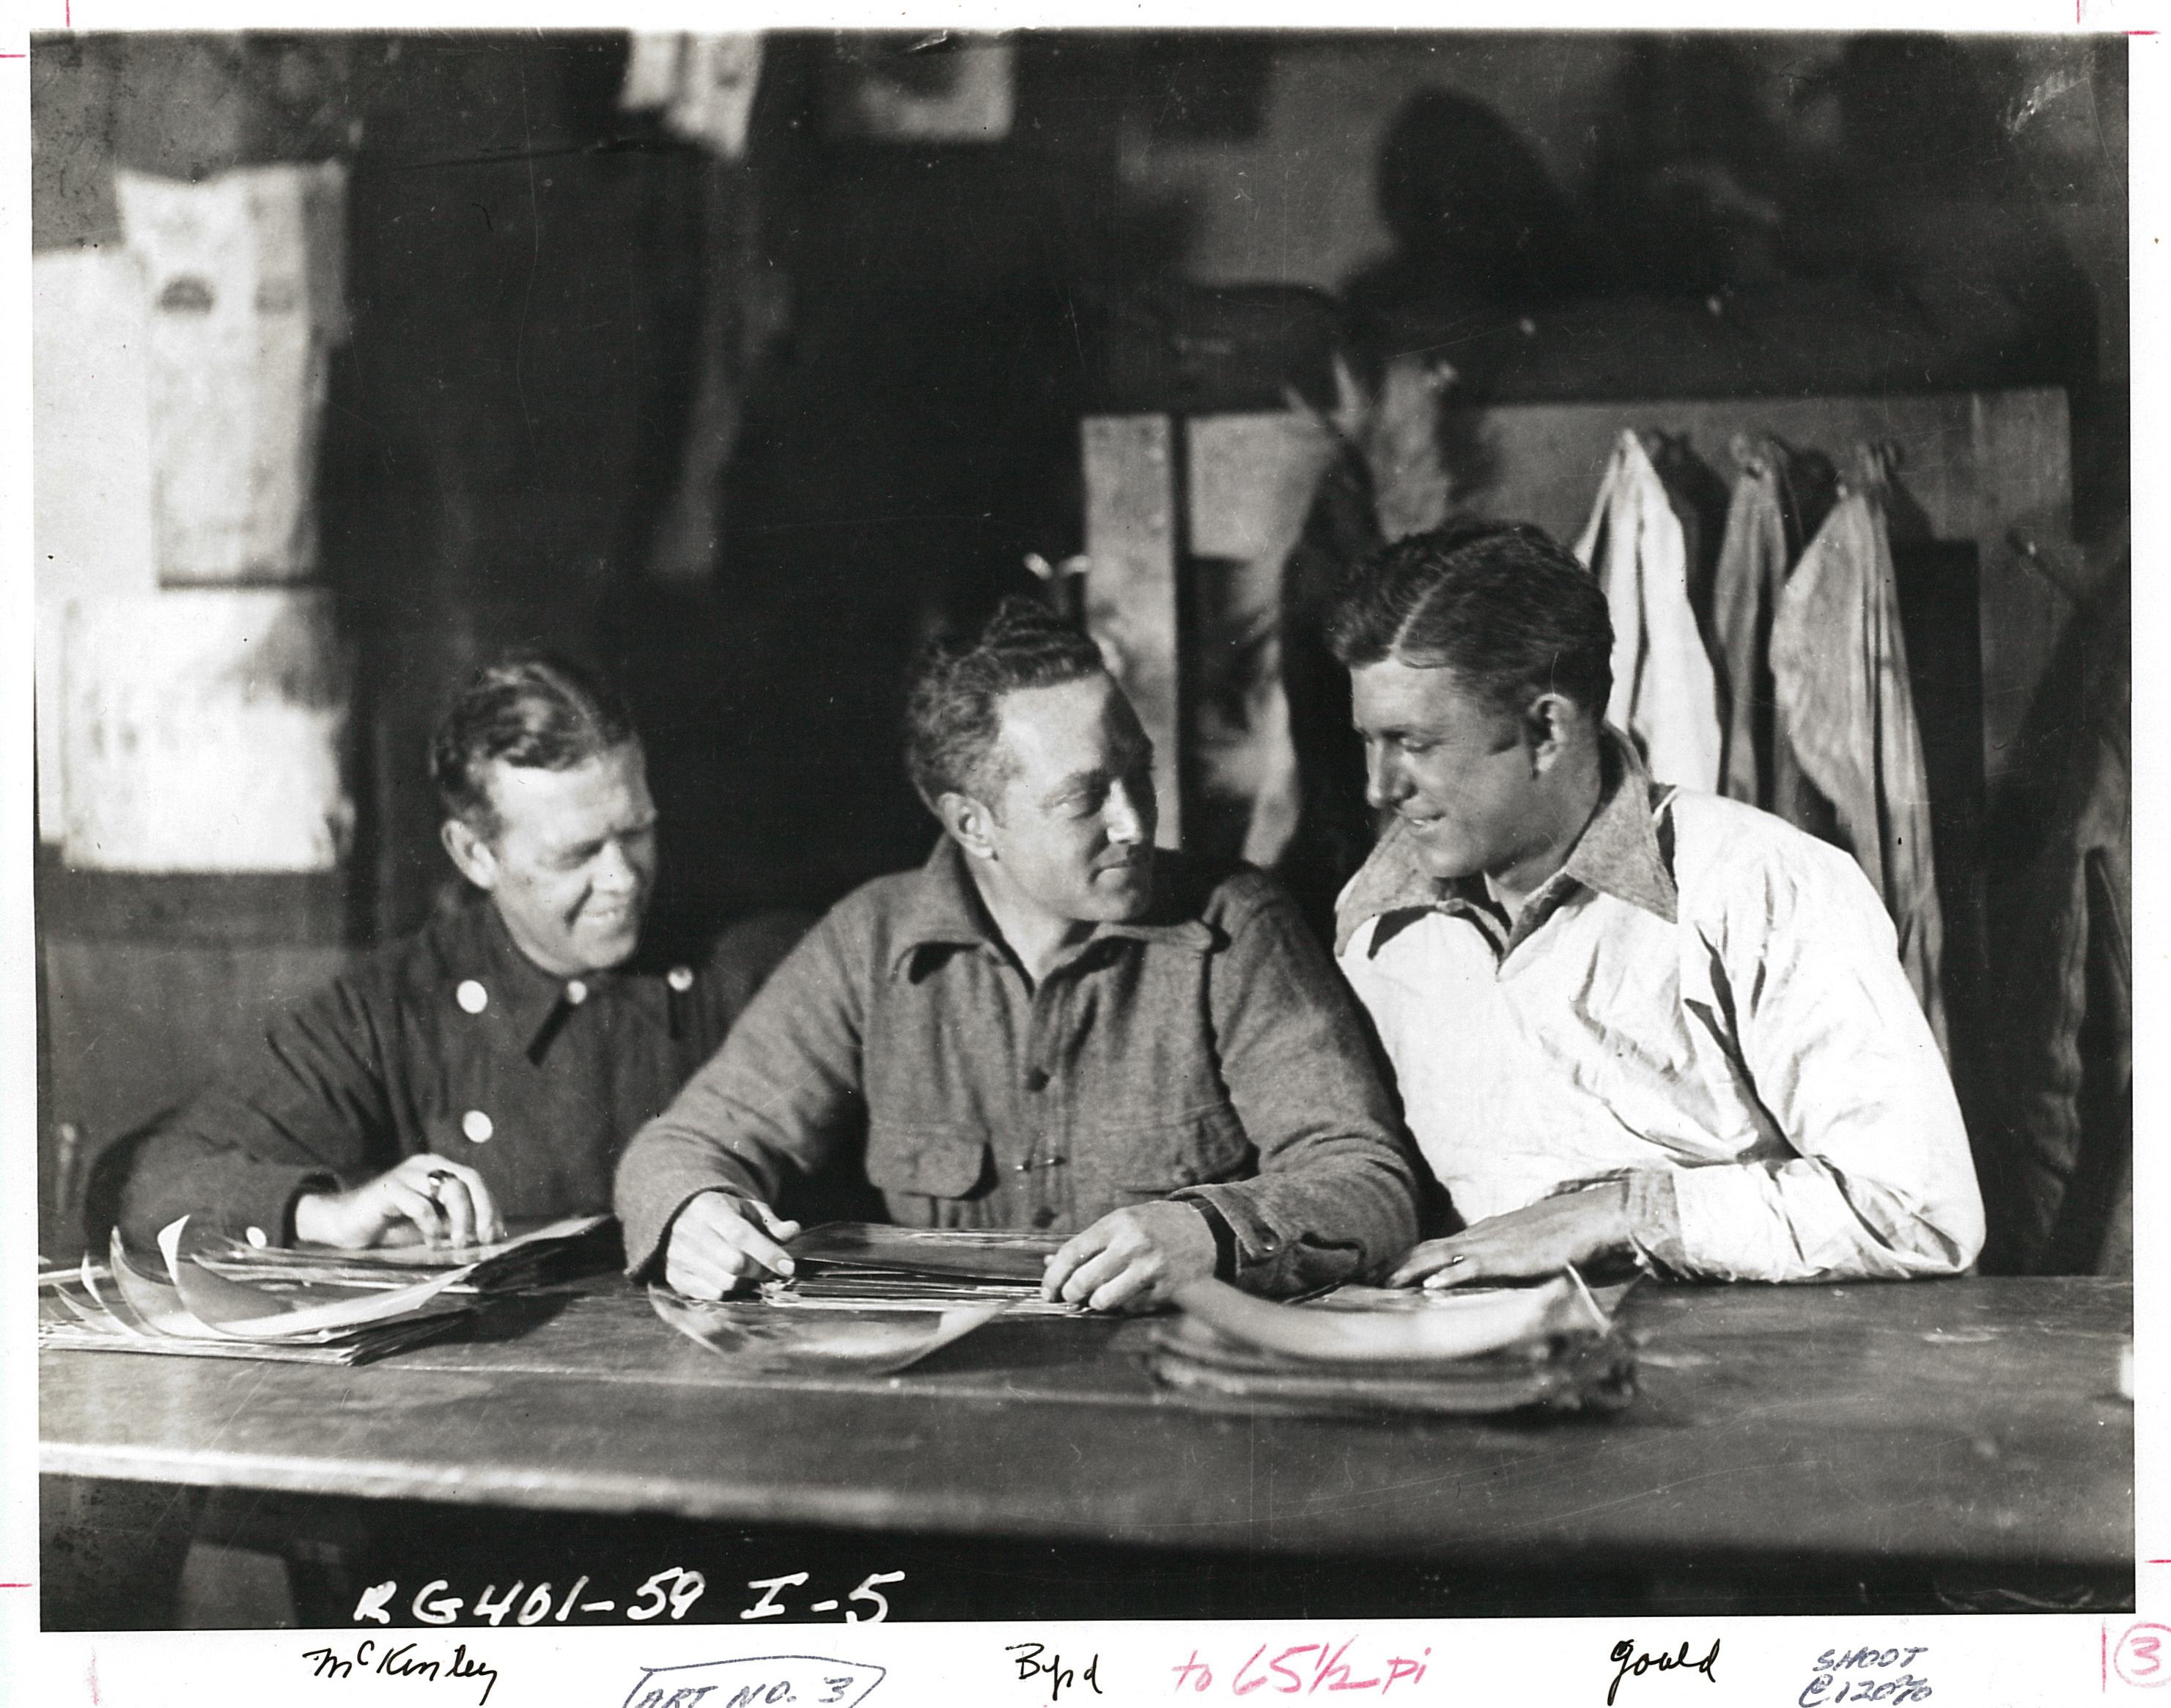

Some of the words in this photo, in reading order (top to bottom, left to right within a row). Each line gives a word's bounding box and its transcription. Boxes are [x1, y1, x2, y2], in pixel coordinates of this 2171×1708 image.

[1005, 1642, 1103, 1701] Byrd
[1171, 1649, 1213, 1693] to
[1812, 1646, 1929, 1672] SHOOT
[2130, 1636, 2161, 1676] 3
[817, 1676, 854, 1703] 3
